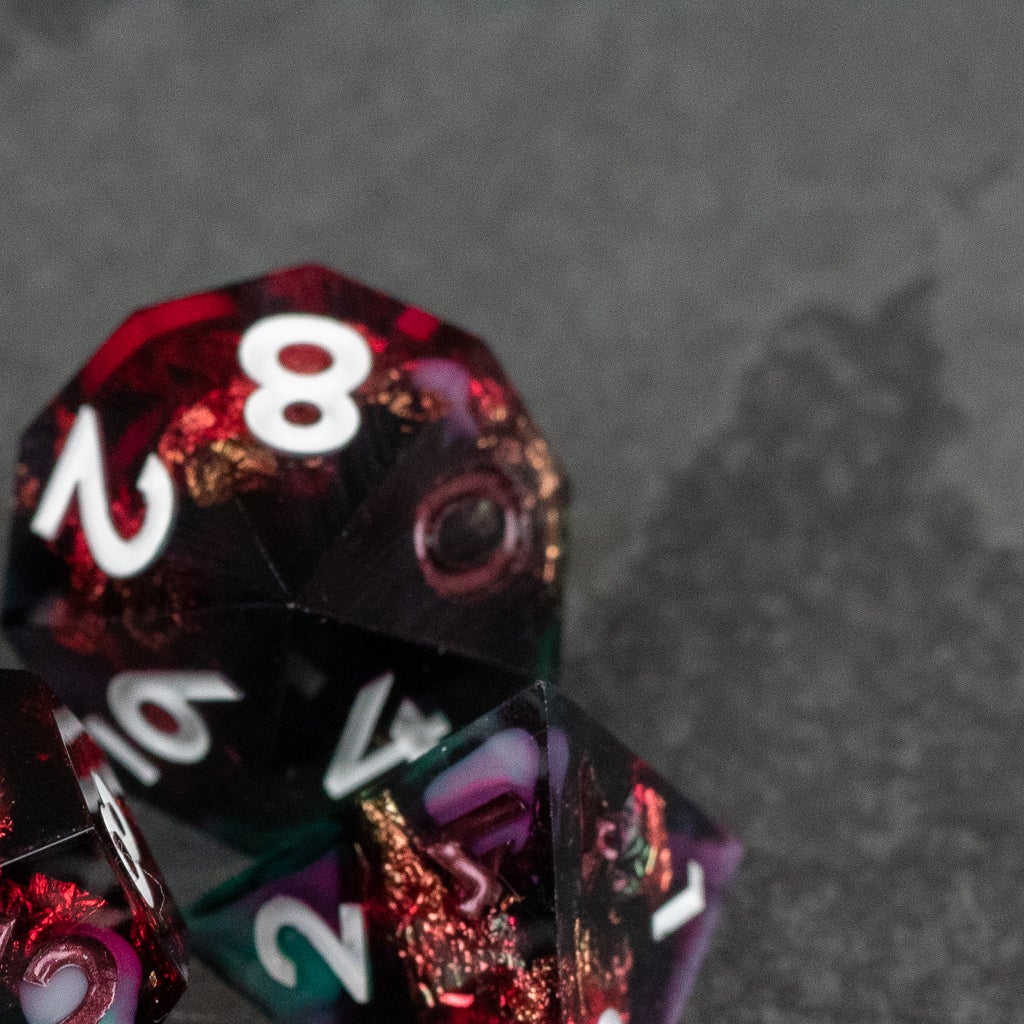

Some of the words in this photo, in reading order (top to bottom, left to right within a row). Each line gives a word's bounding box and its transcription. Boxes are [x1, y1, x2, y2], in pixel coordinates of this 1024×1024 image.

[237, 312, 373, 455] 8
[30, 403, 177, 579] 2
[412, 471, 533, 598] 0
[321, 671, 452, 800] 4
[253, 895, 373, 1006] 2
